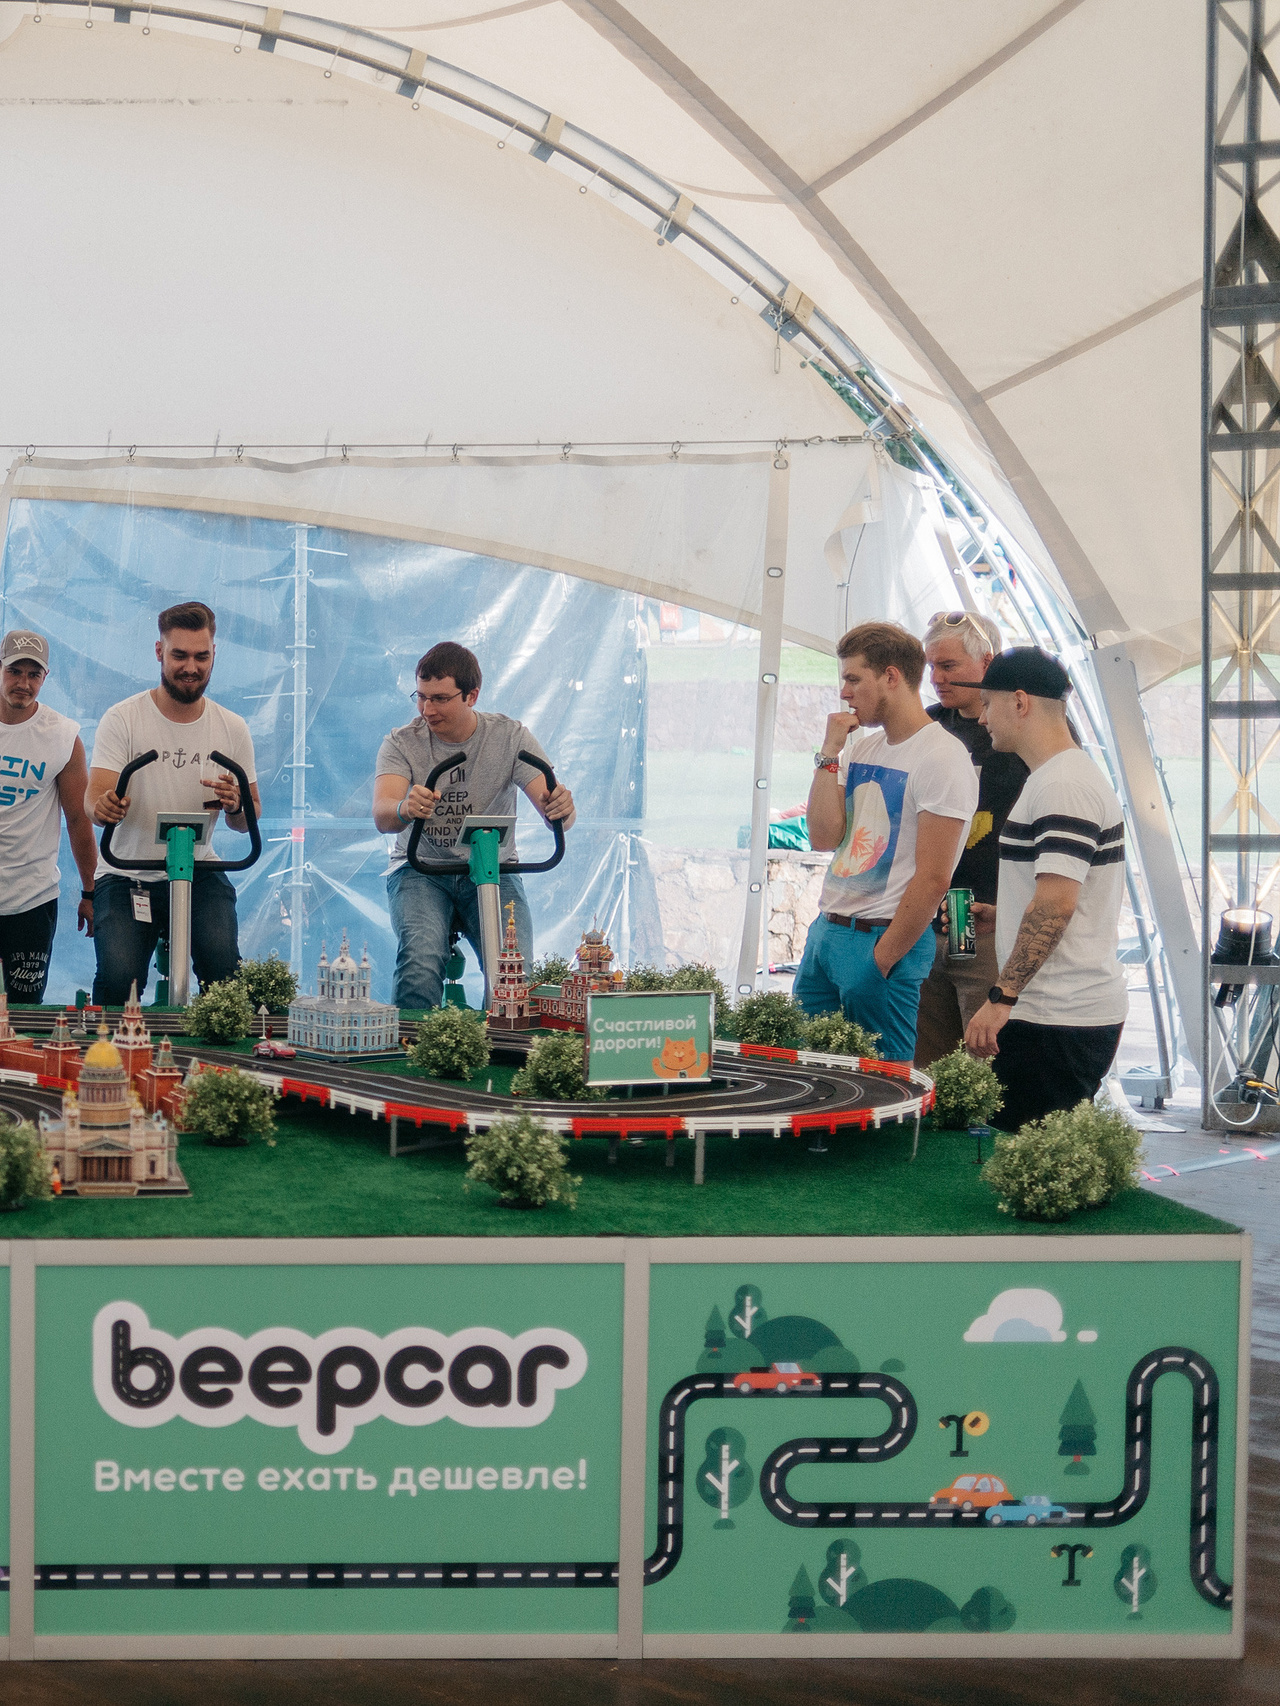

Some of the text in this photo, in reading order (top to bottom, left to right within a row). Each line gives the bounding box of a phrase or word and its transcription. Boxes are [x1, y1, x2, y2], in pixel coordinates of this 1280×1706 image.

[439, 791, 468, 803] KEEP
[434, 804, 473, 816] CALM
[22, 961, 40, 969] 1979
[593, 1015, 697, 1033] Счастливой
[593, 1036, 661, 1054] дороги!
[111, 1319, 570, 1436] beepcar
[94, 1459, 588, 1497] Вместе ехать дешевле!
